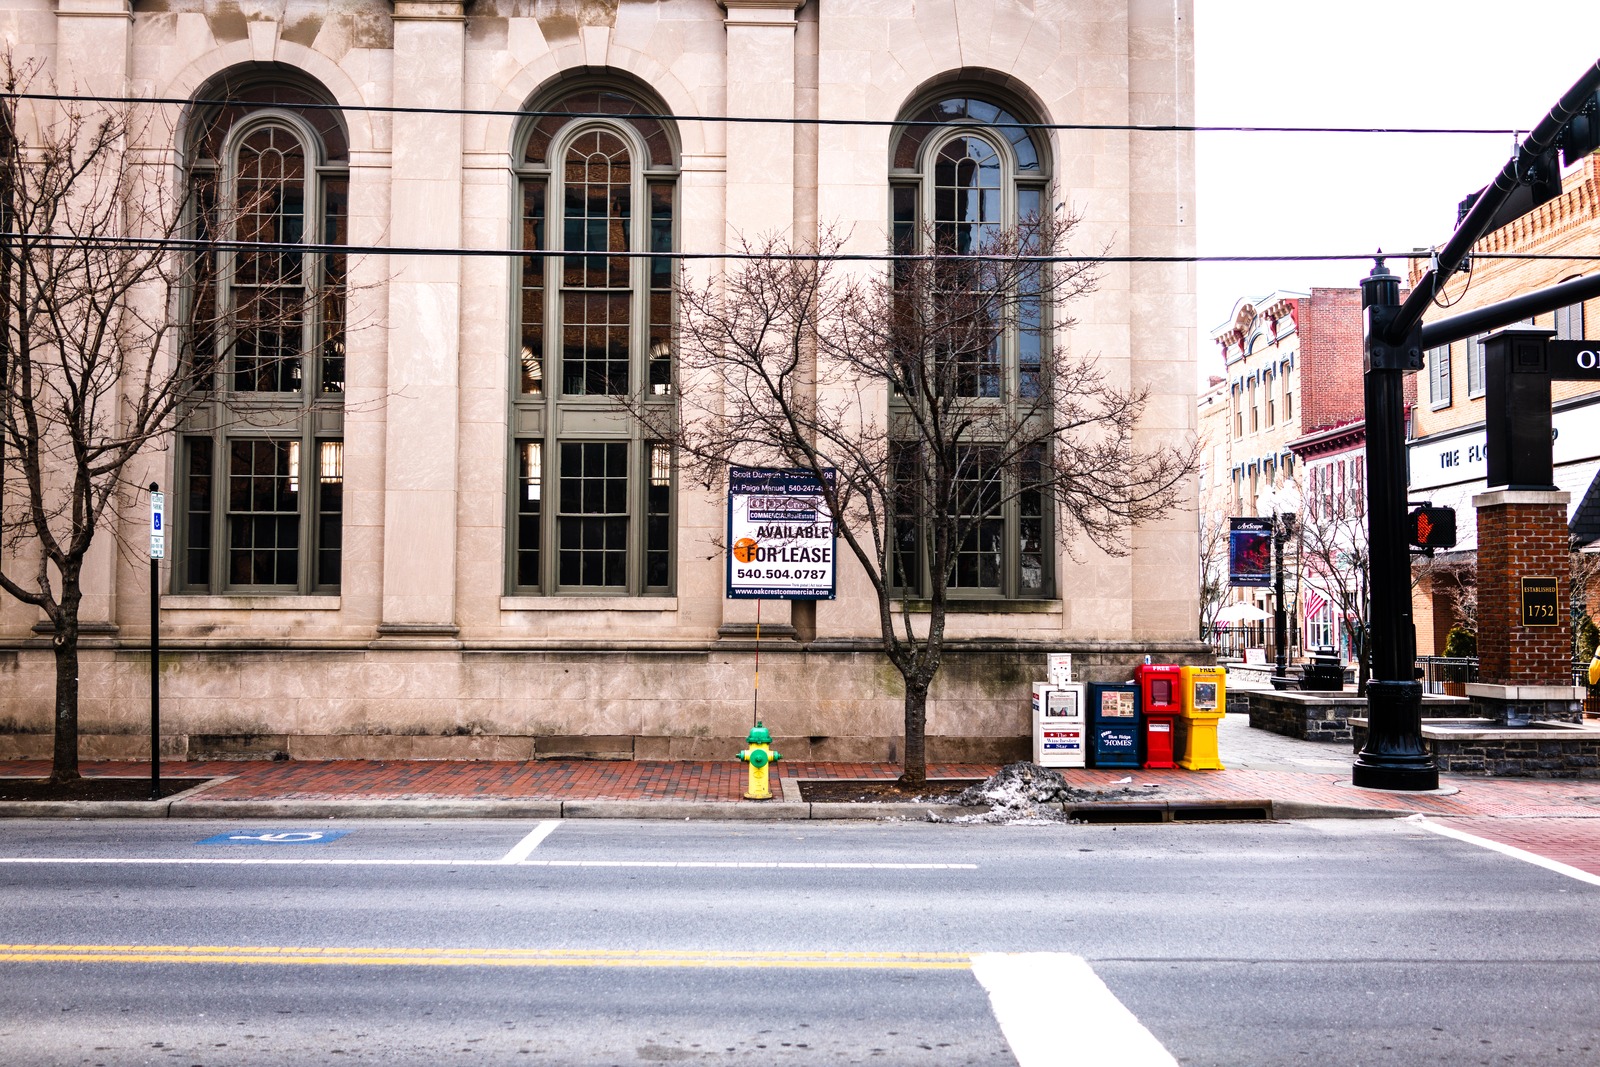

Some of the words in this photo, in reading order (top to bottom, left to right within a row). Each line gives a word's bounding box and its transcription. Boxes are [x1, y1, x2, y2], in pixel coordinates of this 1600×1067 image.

[1440, 449, 1460, 469] THE
[741, 484, 760, 492] Paige
[762, 484, 786, 492] Manuel
[788, 484, 833, 492] 540-247-44
[756, 526, 829, 539] AVAILABLE
[747, 547, 776, 562] FOR
[782, 548, 831, 563] LEASE
[737, 569, 826, 580] 540.504.0787
[735, 588, 829, 596] www.oakcrestcommercial.com
[1528, 605, 1554, 617] 1752
